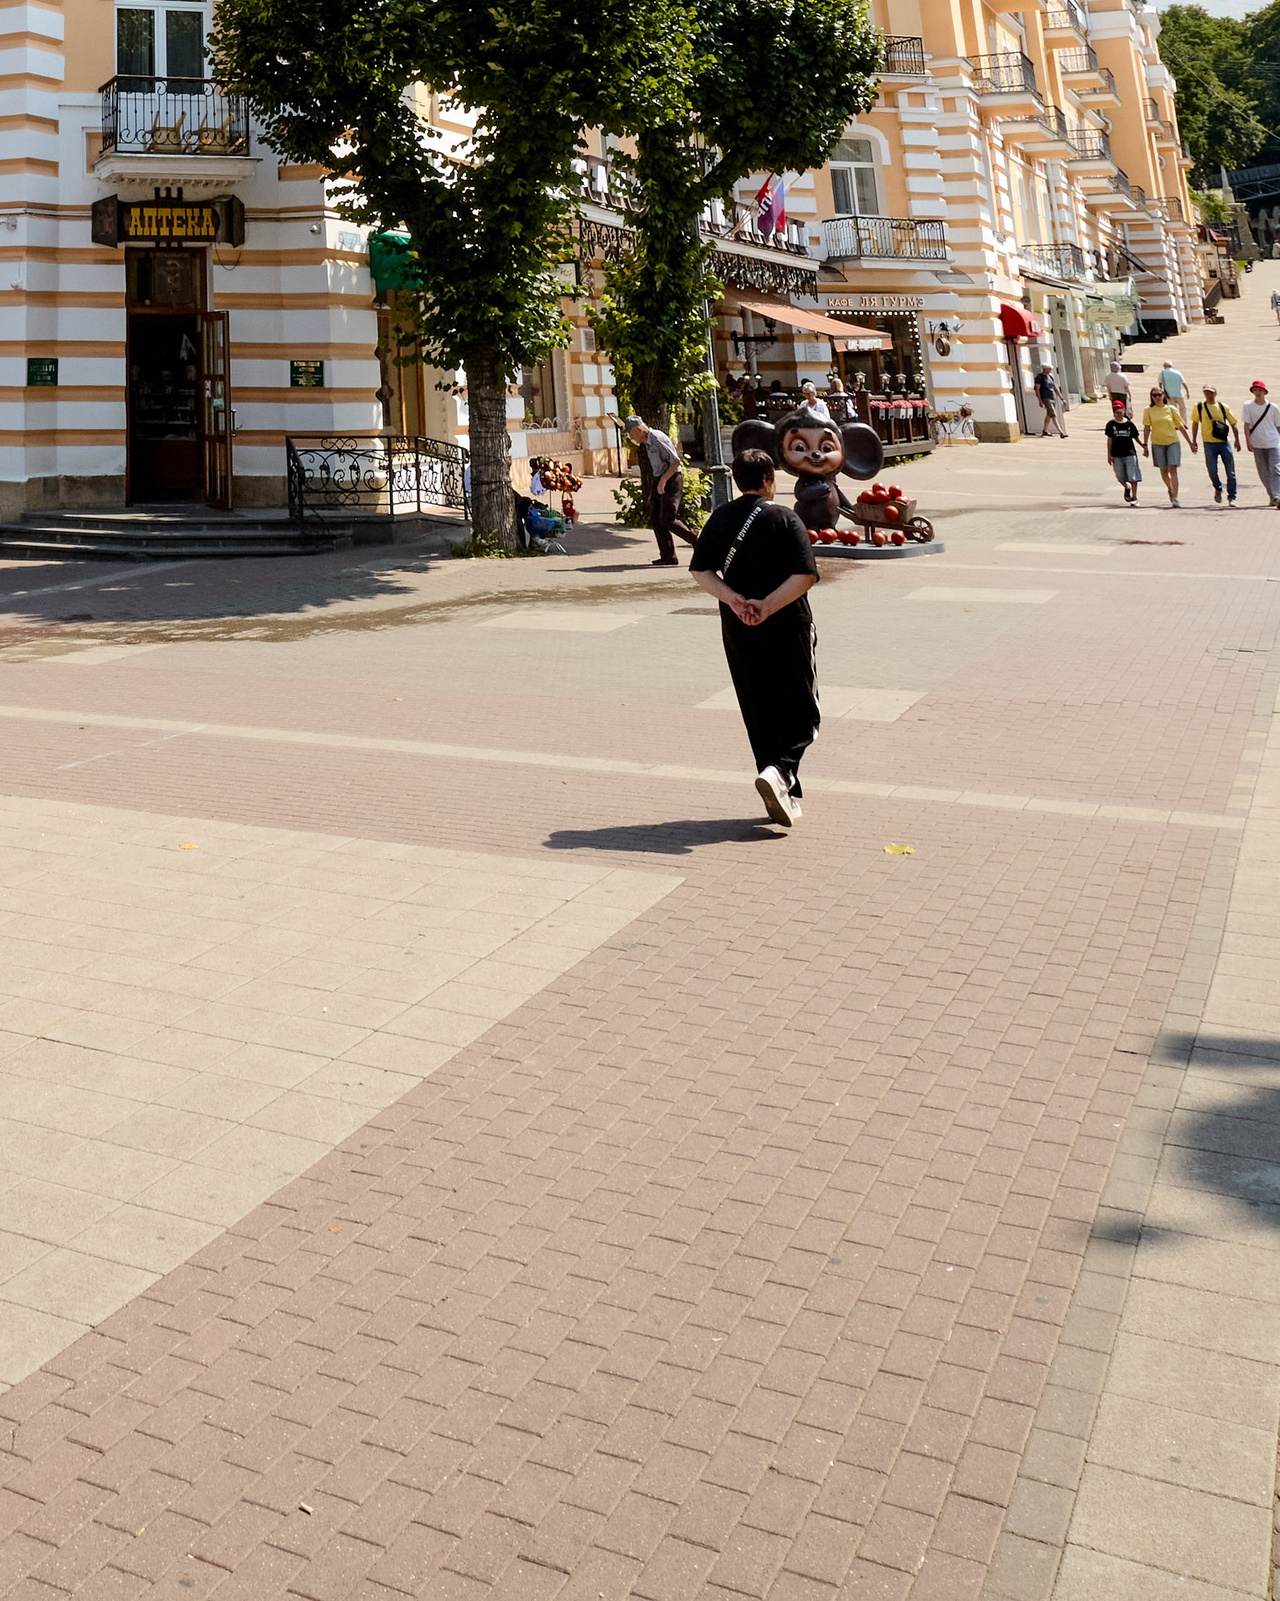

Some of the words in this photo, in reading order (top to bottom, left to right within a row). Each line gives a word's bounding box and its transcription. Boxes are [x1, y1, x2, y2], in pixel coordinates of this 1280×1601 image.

[129, 208, 215, 236] АПТЕКА
[828, 298, 854, 307] КАФЕ
[860, 296, 878, 307] ЛЯ
[882, 296, 926, 308] ГУРМЭ
[736, 506, 763, 542] BALENCIAGA
